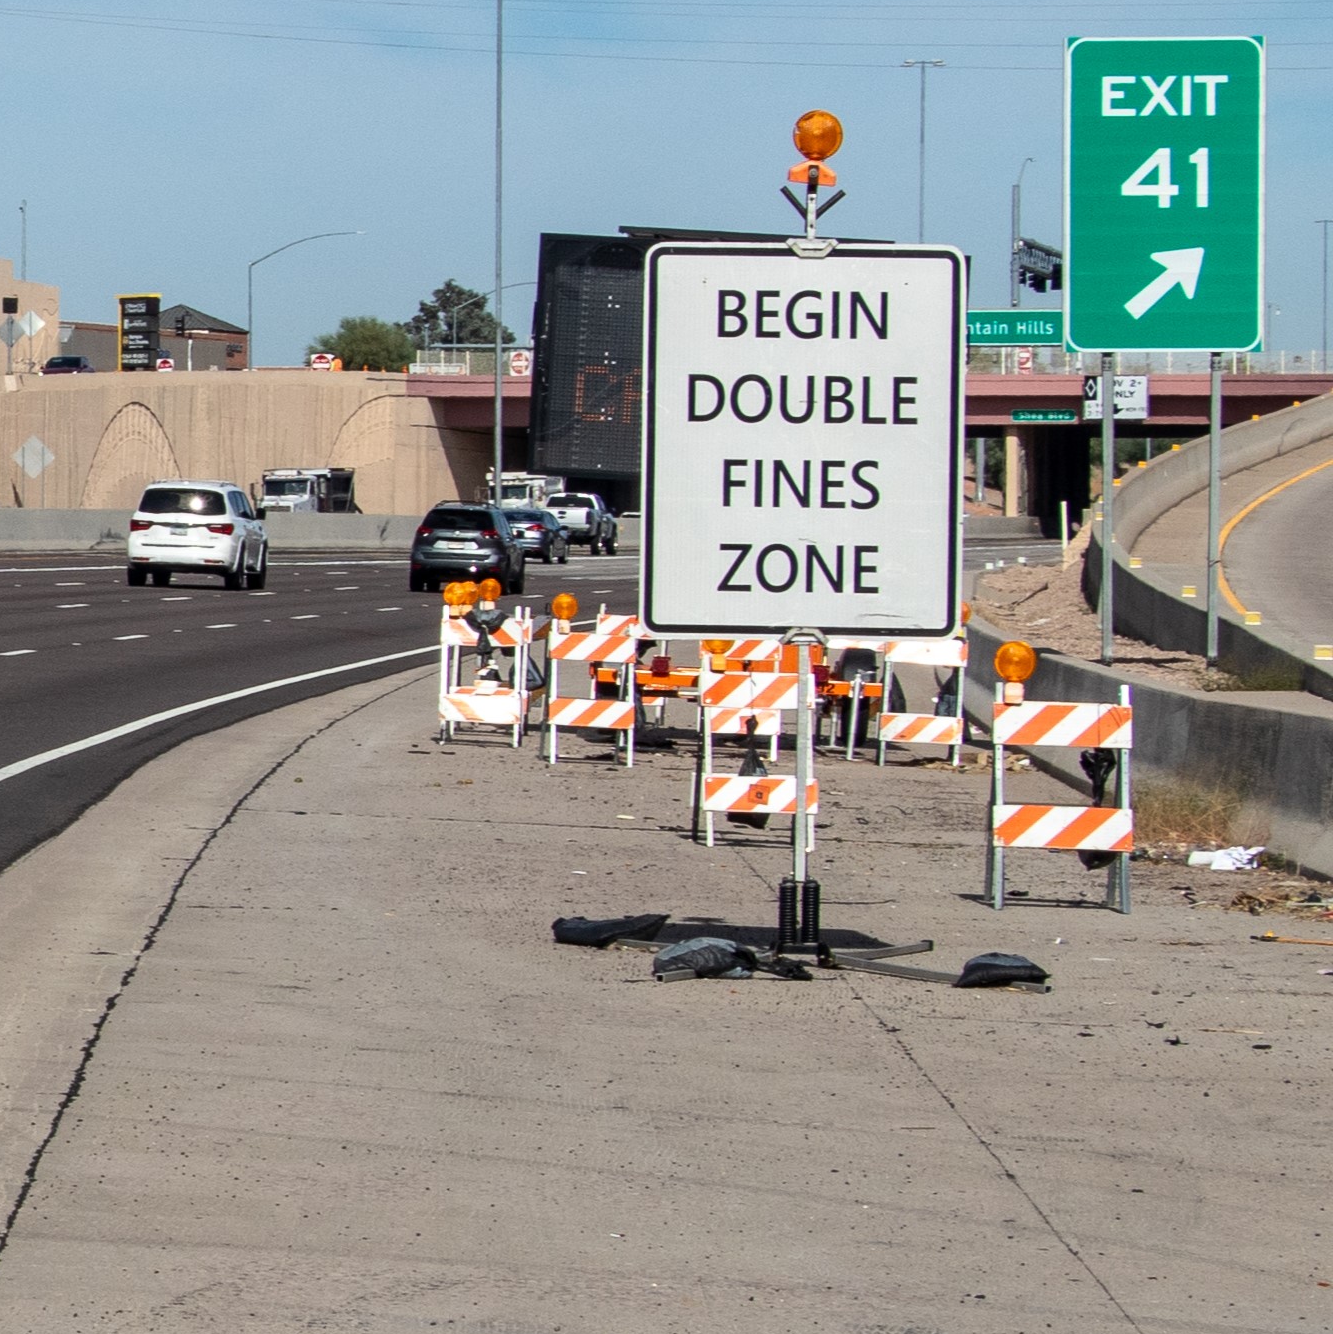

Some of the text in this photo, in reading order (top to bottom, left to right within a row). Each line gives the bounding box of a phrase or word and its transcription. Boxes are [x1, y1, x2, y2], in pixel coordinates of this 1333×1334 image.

[1101, 75, 1229, 117] EXIT
[1120, 147, 1209, 209] 41
[717, 289, 890, 341] BEGIN
[1016, 320, 1055, 335] Hills
[687, 373, 919, 425] DOUBLE
[722, 458, 881, 510] FINES
[716, 543, 880, 595] ZONE
